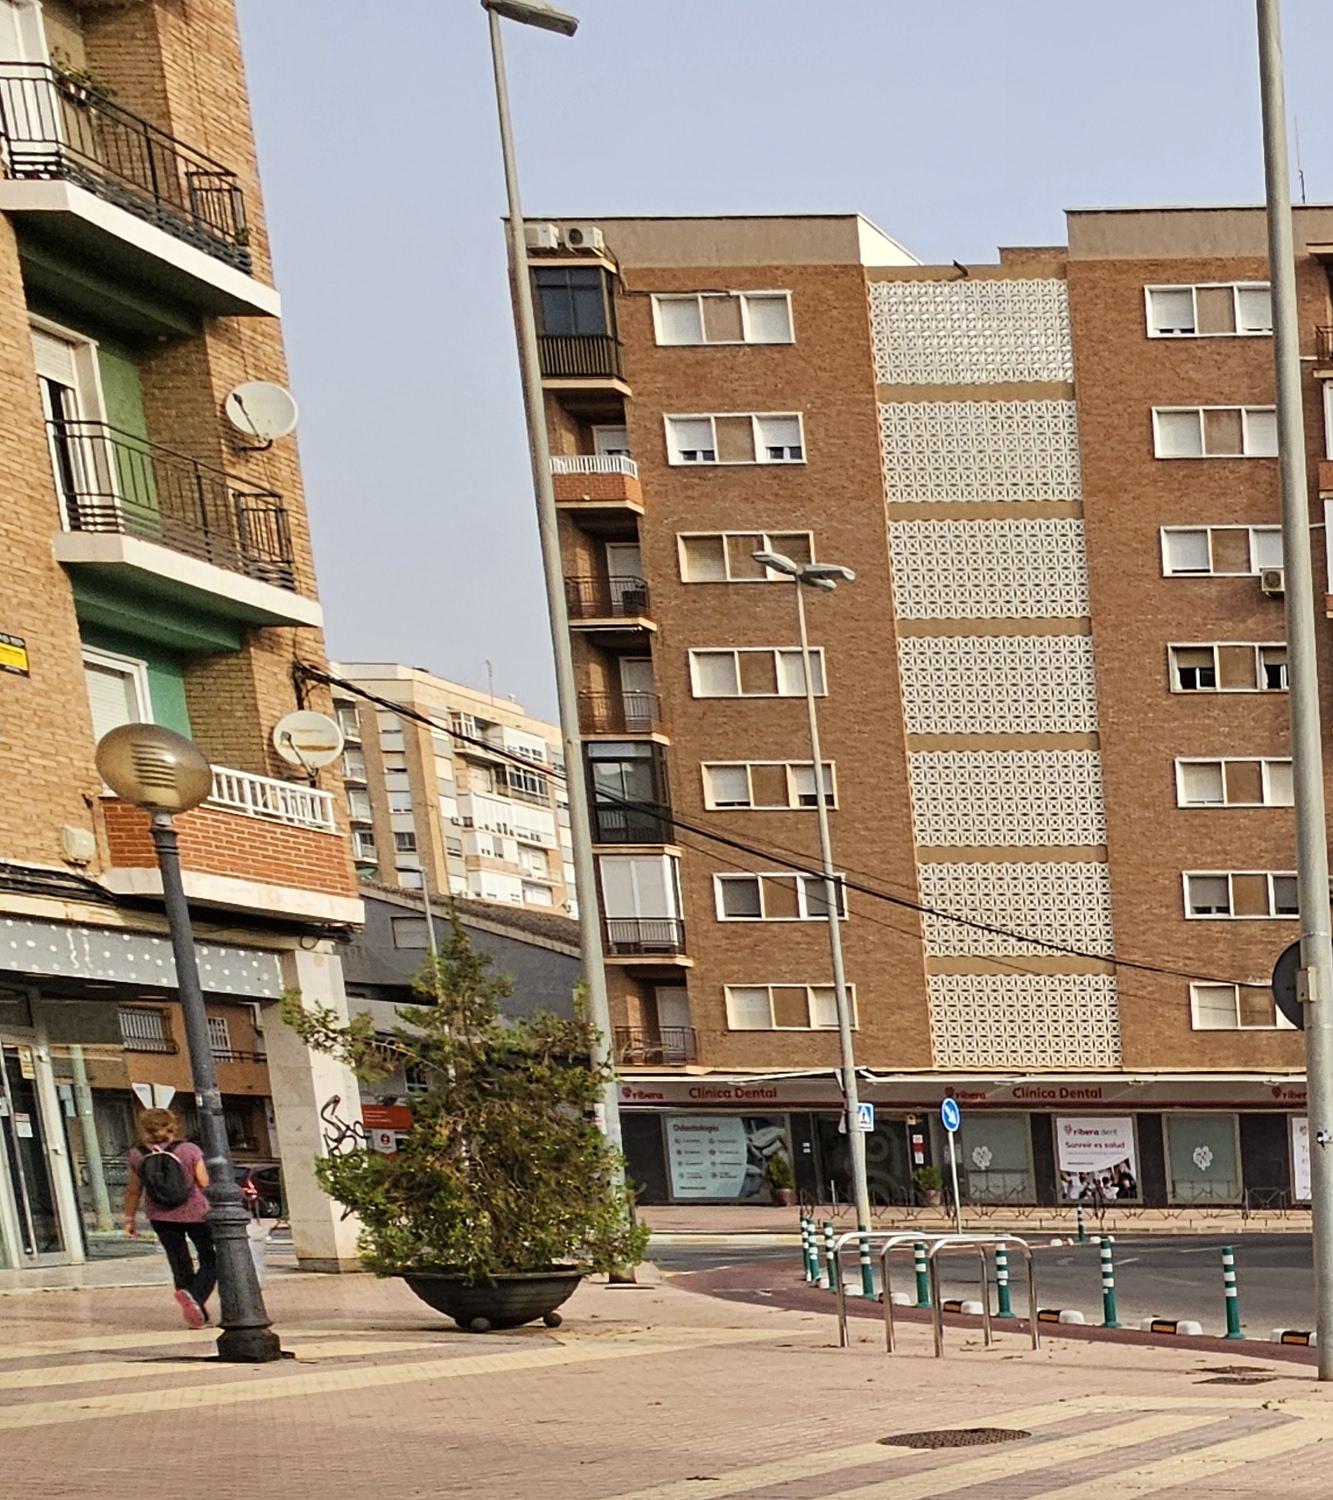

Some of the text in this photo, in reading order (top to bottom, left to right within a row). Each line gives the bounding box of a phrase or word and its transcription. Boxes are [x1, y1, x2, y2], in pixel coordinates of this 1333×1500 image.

[632, 1090, 663, 1099] ribera
[688, 1087, 777, 1098] Clínica Dental
[955, 1089, 986, 1099] ribera
[1012, 1087, 1102, 1099] Clínica Dental
[1283, 1089, 1307, 1099] riber
[1073, 1128, 1117, 1136] ribera dent
[1104, 1140, 1125, 1149] salud
